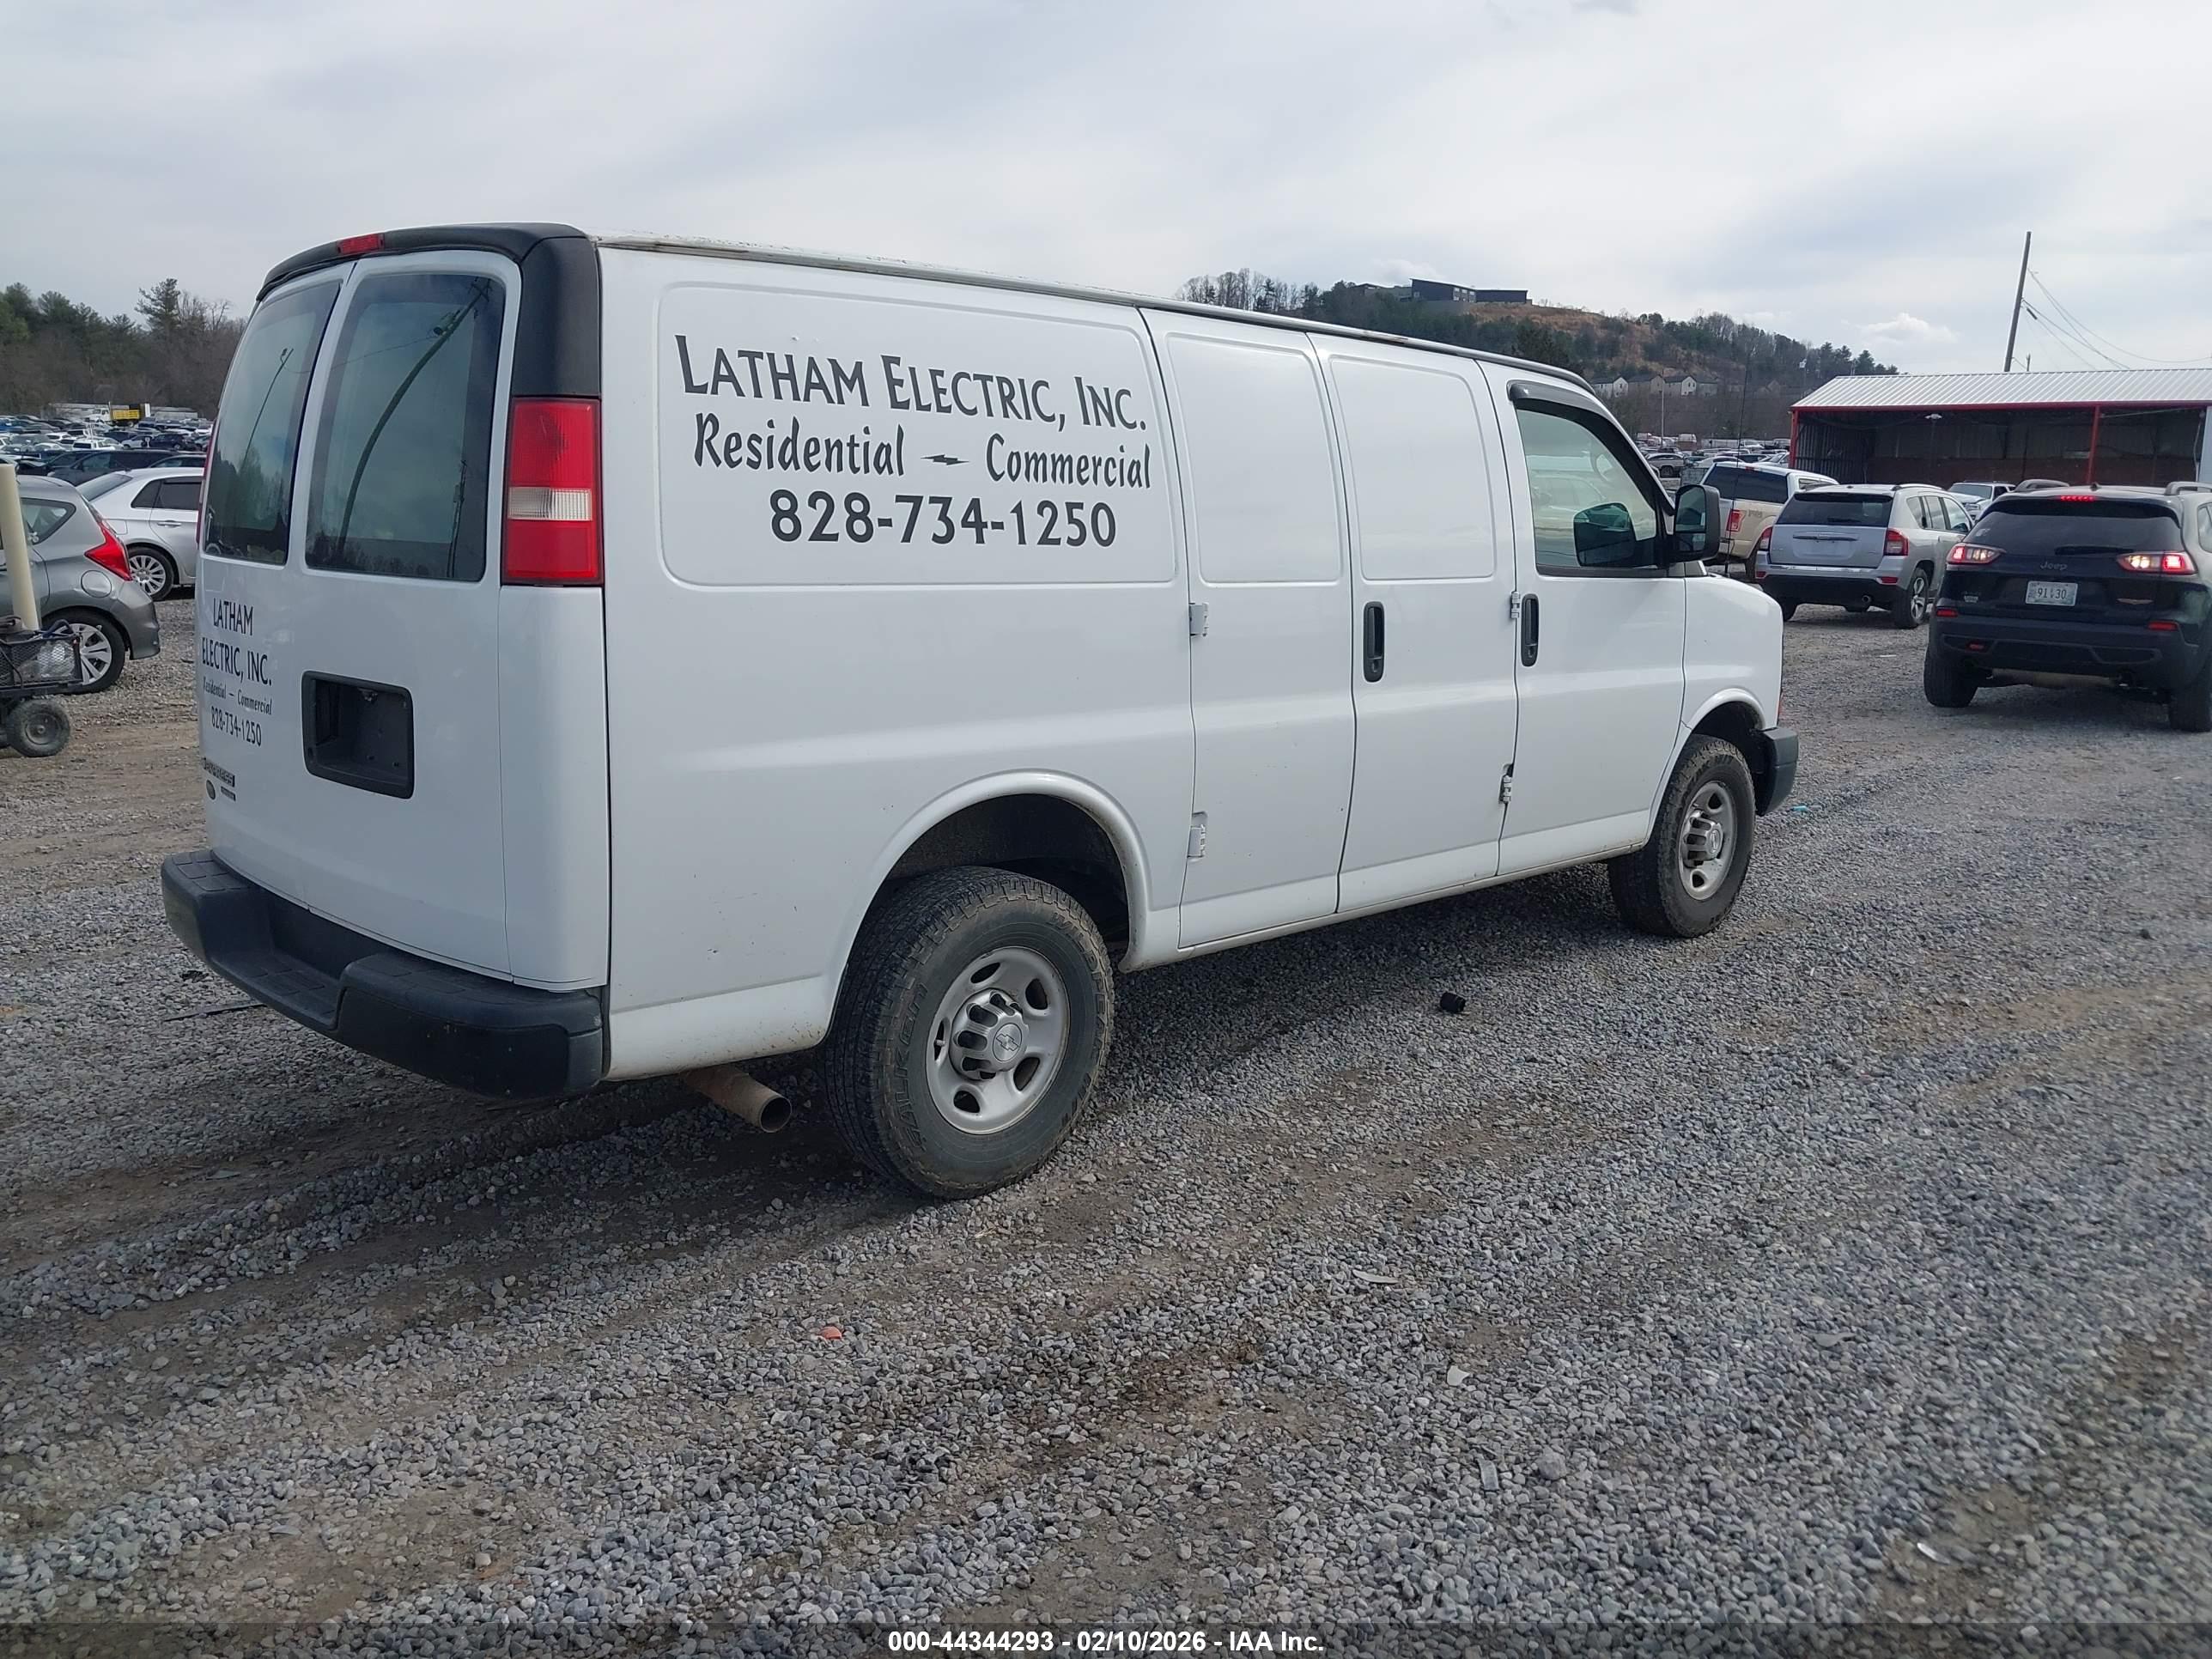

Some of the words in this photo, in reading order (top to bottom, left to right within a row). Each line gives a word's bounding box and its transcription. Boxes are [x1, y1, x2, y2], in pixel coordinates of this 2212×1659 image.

[675, 334, 870, 407] LATHAM
[880, 355, 1066, 432] ELECTRIC,
[1073, 376, 1147, 431] INC.
[694, 412, 905, 477] Residential
[986, 433, 1151, 489] Commercial
[769, 489, 1116, 547] 828-734-1250
[213, 598, 253, 635] LATHAM
[202, 637, 244, 684] ELECTRIC,
[247, 651, 271, 686] INC.
[211, 706, 261, 746] 828-734-1250
[238, 689, 271, 715] Commercial
